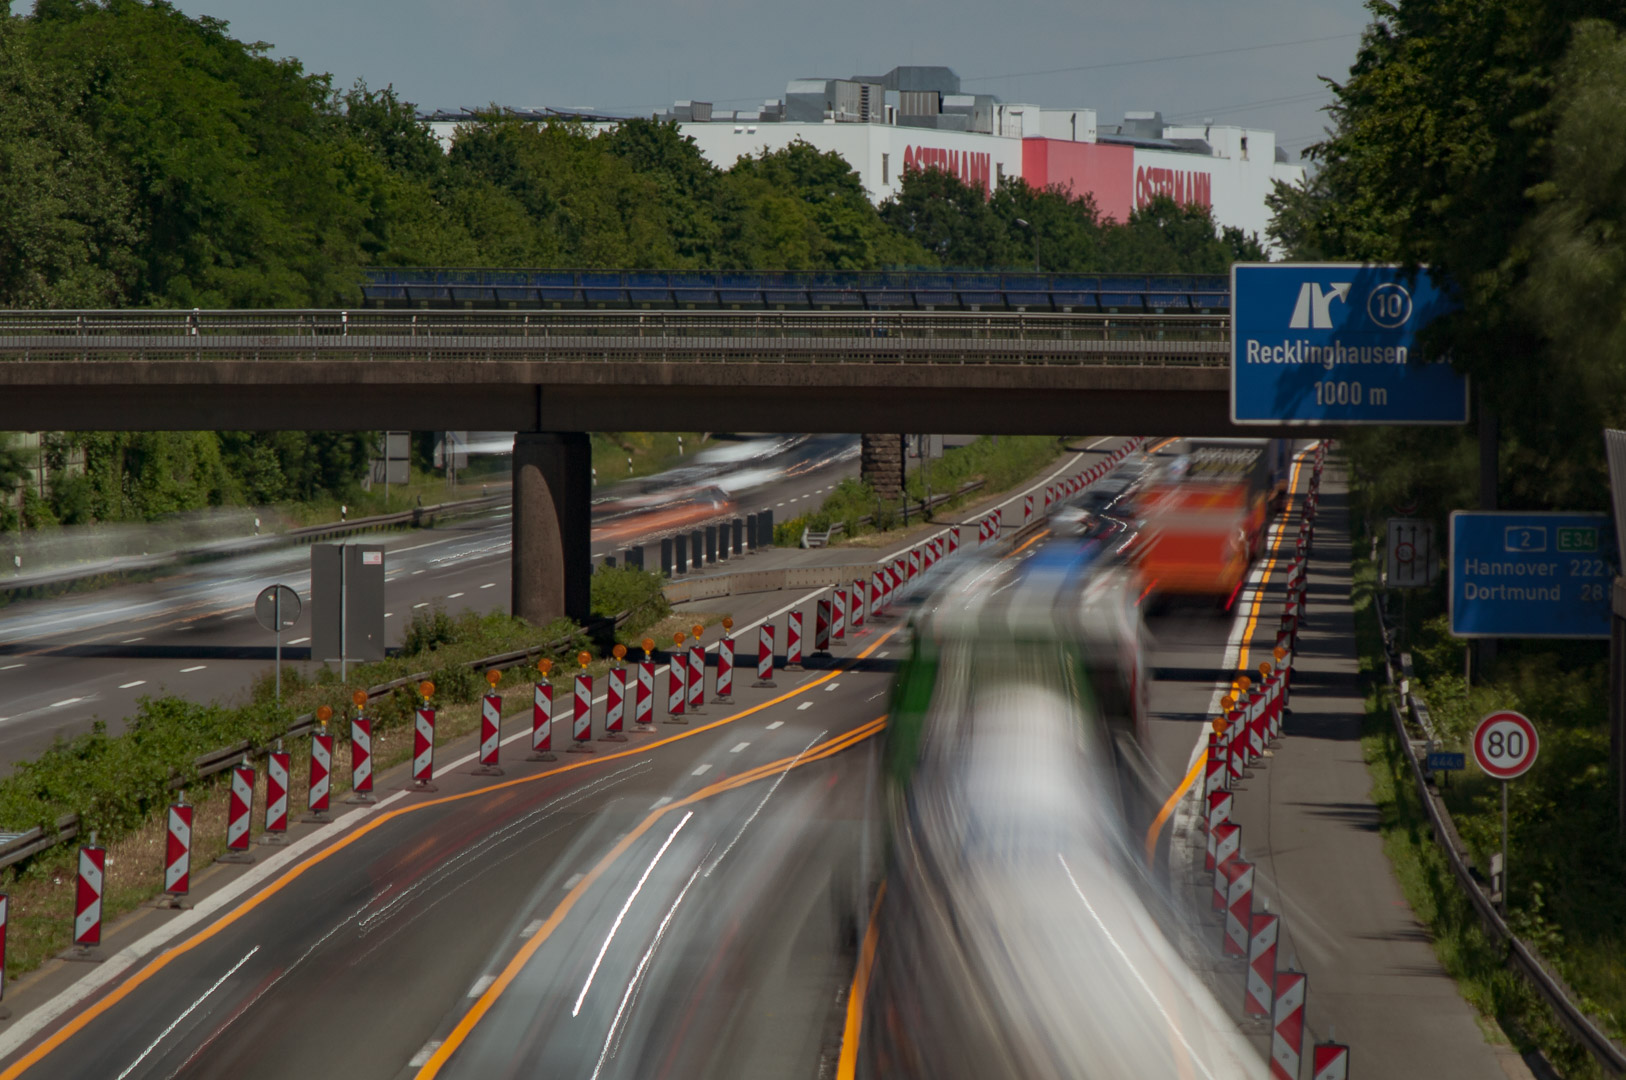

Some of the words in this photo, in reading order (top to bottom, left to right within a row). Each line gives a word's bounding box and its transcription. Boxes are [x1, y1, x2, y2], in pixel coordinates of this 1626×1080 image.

[1136, 165, 1211, 213] OSTERMANN
[1377, 294, 1402, 318] 10
[1314, 381, 1362, 405] 1000
[1370, 388, 1387, 405] m
[1521, 531, 1531, 547] 2
[1464, 558, 1558, 576] Hannover
[1570, 559, 1604, 577] 222
[1464, 582, 1561, 600] Dortmund
[1580, 583, 1604, 601] 28
[1488, 731, 1524, 759] 80
